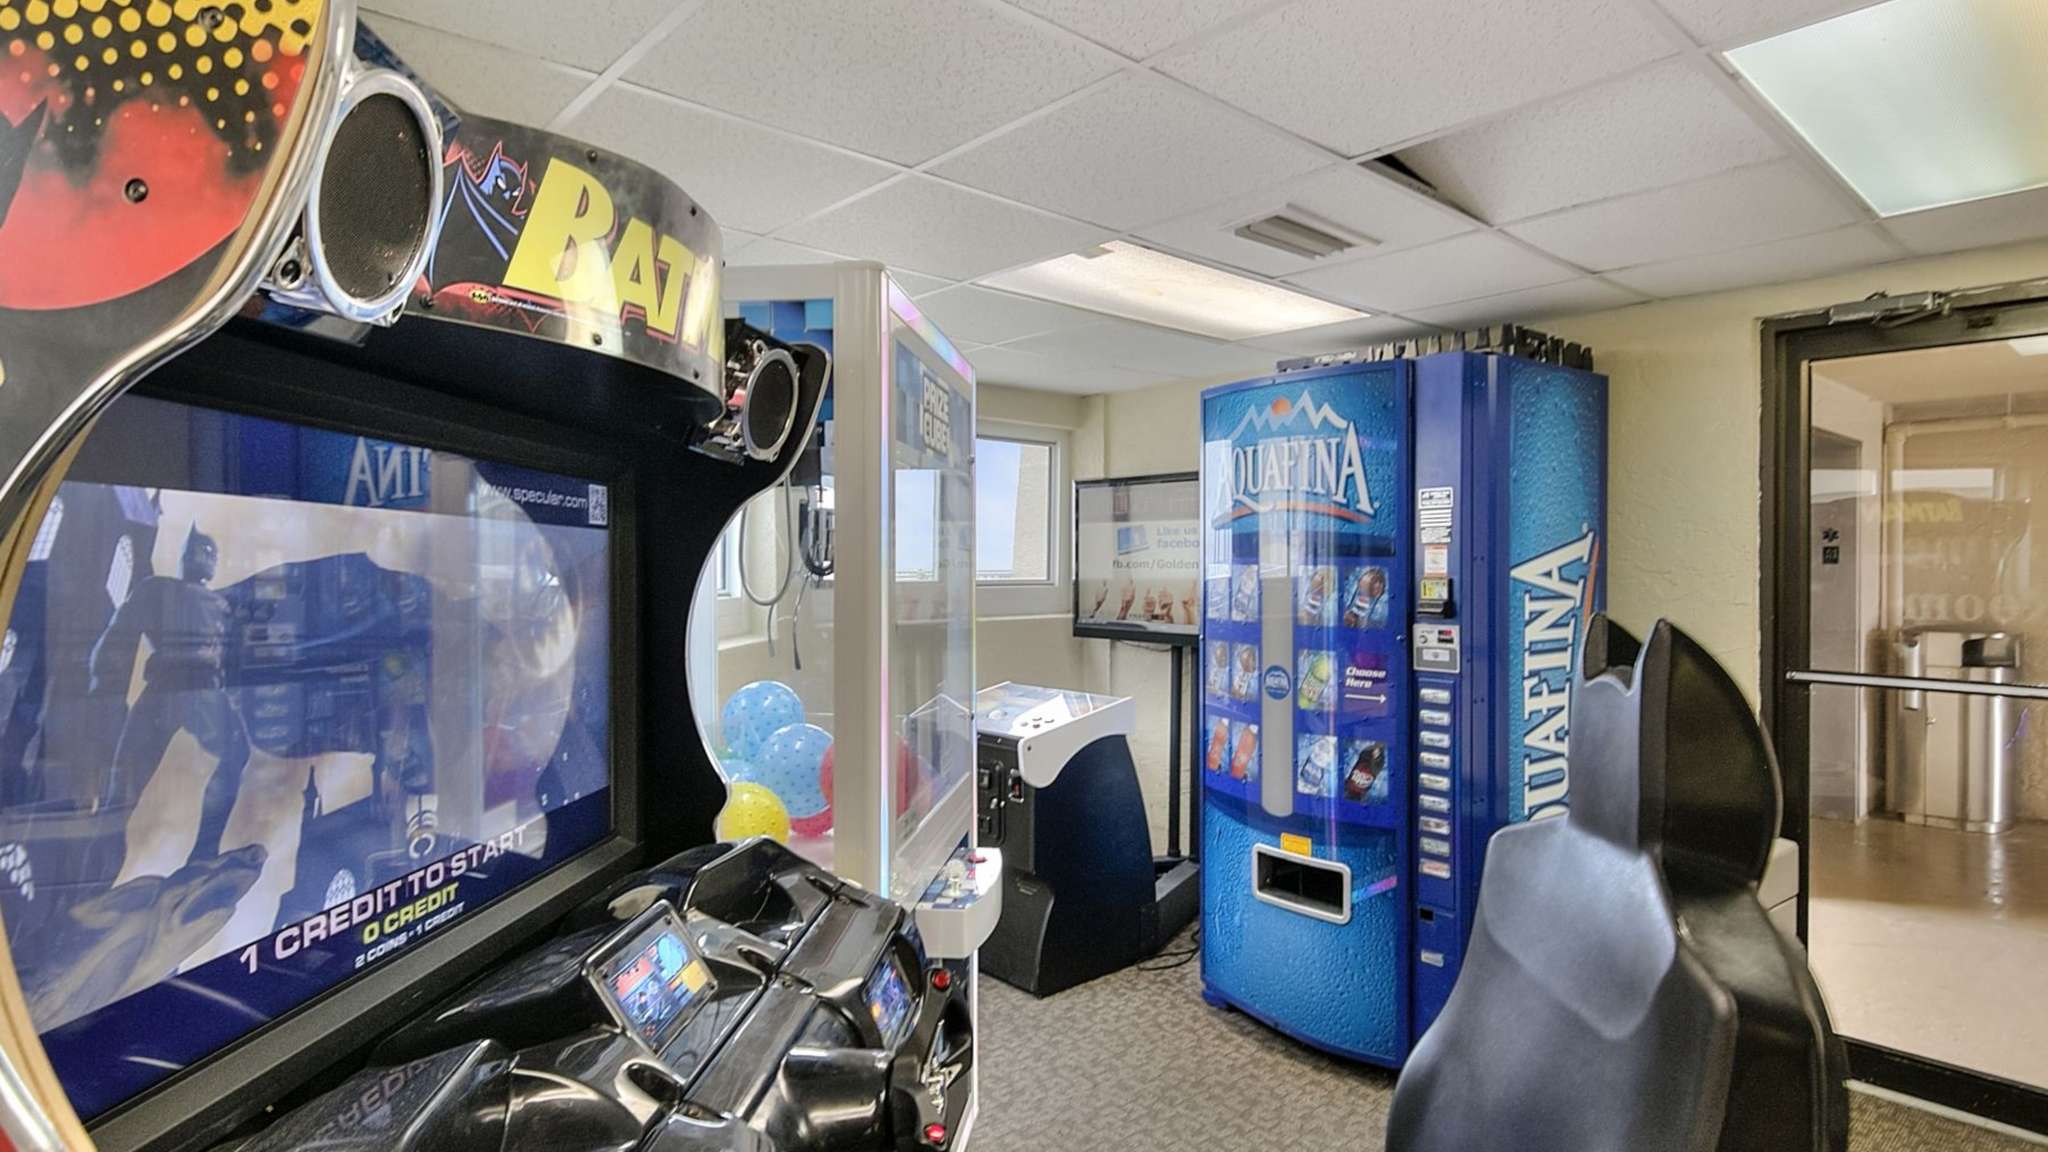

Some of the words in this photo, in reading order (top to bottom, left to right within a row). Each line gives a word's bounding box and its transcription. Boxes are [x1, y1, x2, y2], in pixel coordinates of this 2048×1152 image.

[923, 377, 949, 424] PRIZE
[923, 413, 950, 455] CUBE
[1211, 421, 1376, 522] AQUAFINA
[478, 482, 588, 509] www.specular.com
[1157, 526, 1181, 537] Like
[1184, 528, 1198, 537] us
[1345, 677, 1373, 689] Here
[1346, 666, 1387, 679] Choose
[240, 944, 258, 974] 1
[274, 881, 405, 961] CREDIT
[407, 865, 445, 897] TO
[449, 825, 528, 877] START
[382, 882, 460, 935] CREDIT
[355, 953, 366, 969] 2
[366, 931, 408, 963] COINS
[424, 901, 465, 932] CREDIT
